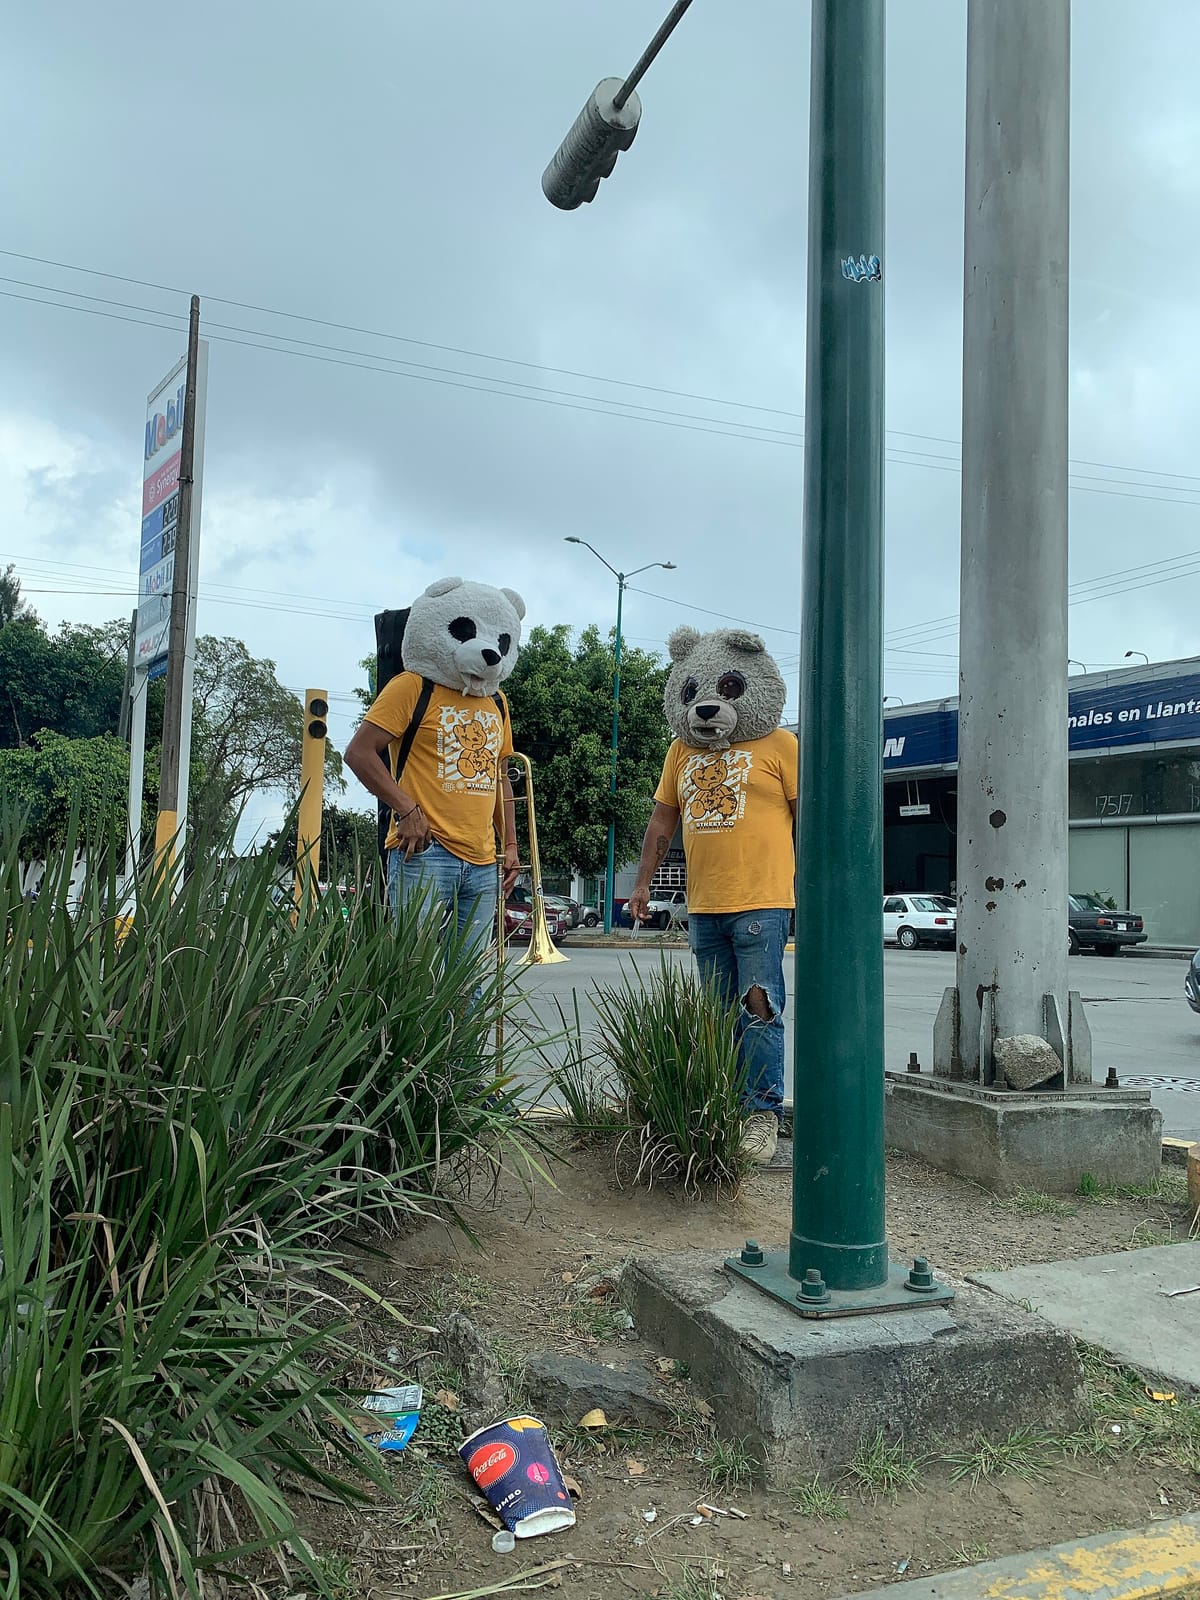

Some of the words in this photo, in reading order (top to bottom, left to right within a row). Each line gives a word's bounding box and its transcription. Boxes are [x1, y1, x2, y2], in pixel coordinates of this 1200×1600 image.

[145, 384, 186, 460] Mobil
[1118, 708, 1141, 723] en
[495, 1489, 522, 1512] UMBO
